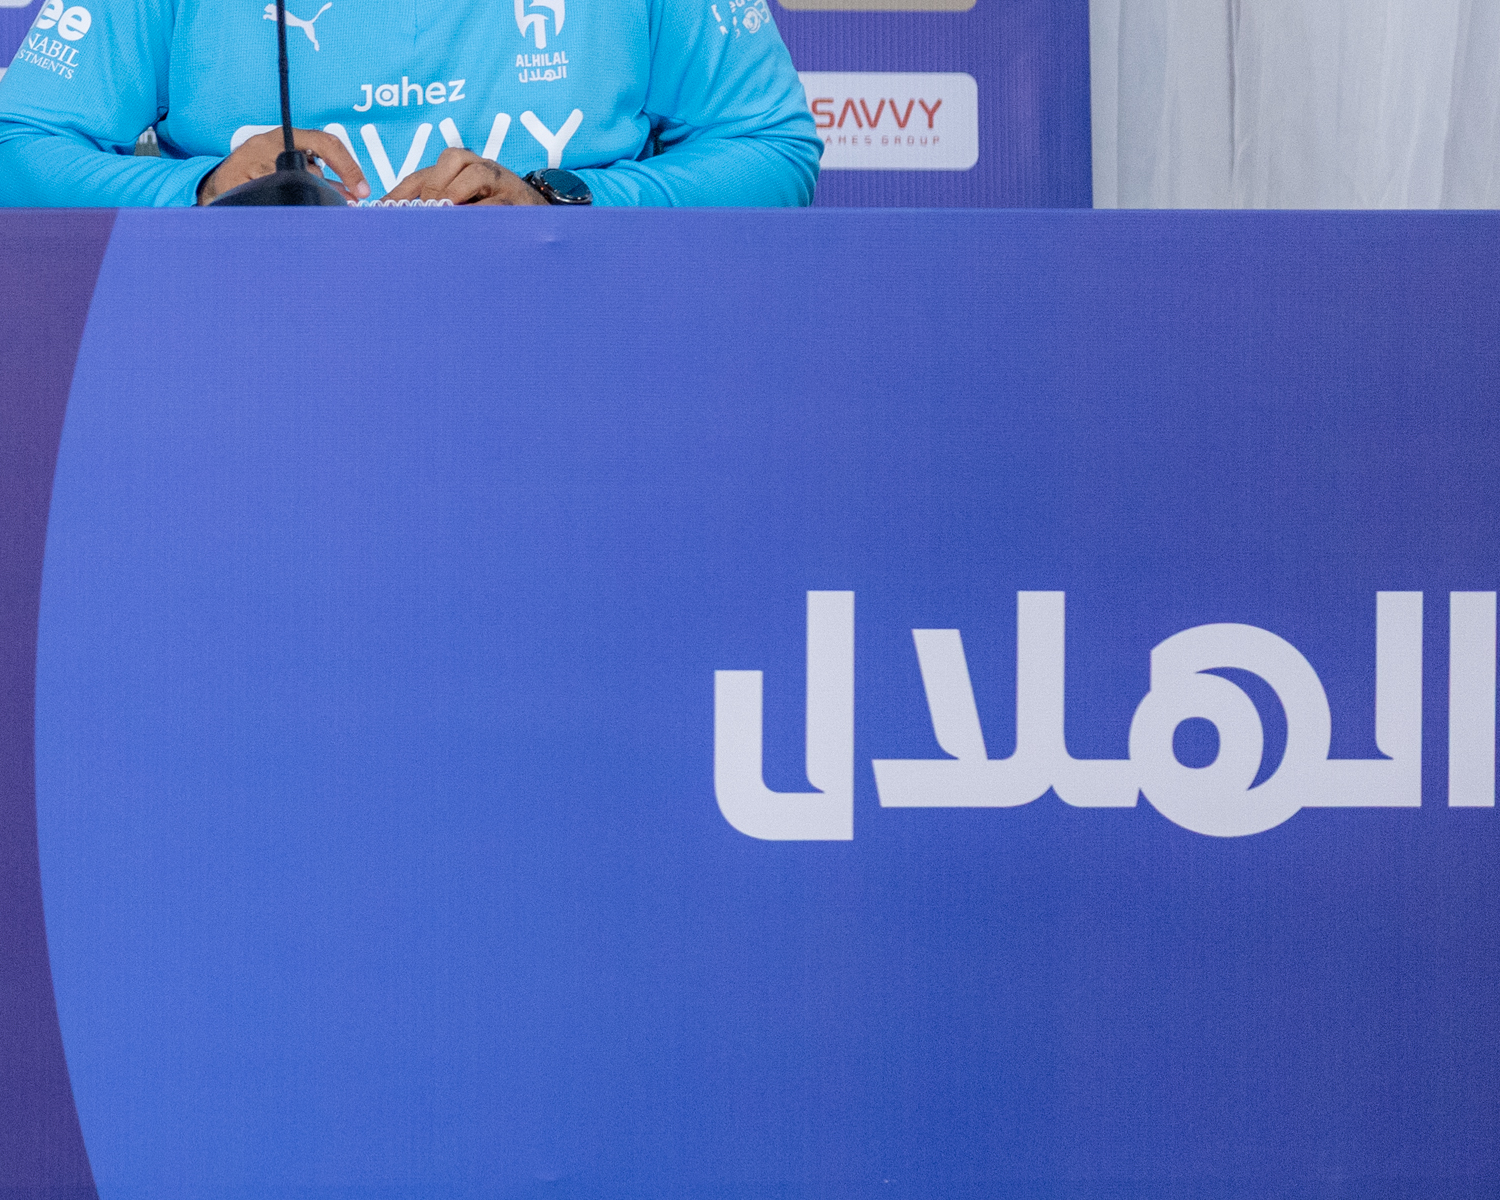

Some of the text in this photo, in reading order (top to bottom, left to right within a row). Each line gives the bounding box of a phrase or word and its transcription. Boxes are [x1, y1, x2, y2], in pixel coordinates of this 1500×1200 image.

[515, 50, 569, 67] ALHILAL
[518, 65, 568, 83] الهلال
[353, 76, 466, 112] jahez
[811, 98, 942, 129] SAVVY
[825, 135, 940, 145] AMES GROUP
[713, 590, 1498, 841] الهلال
